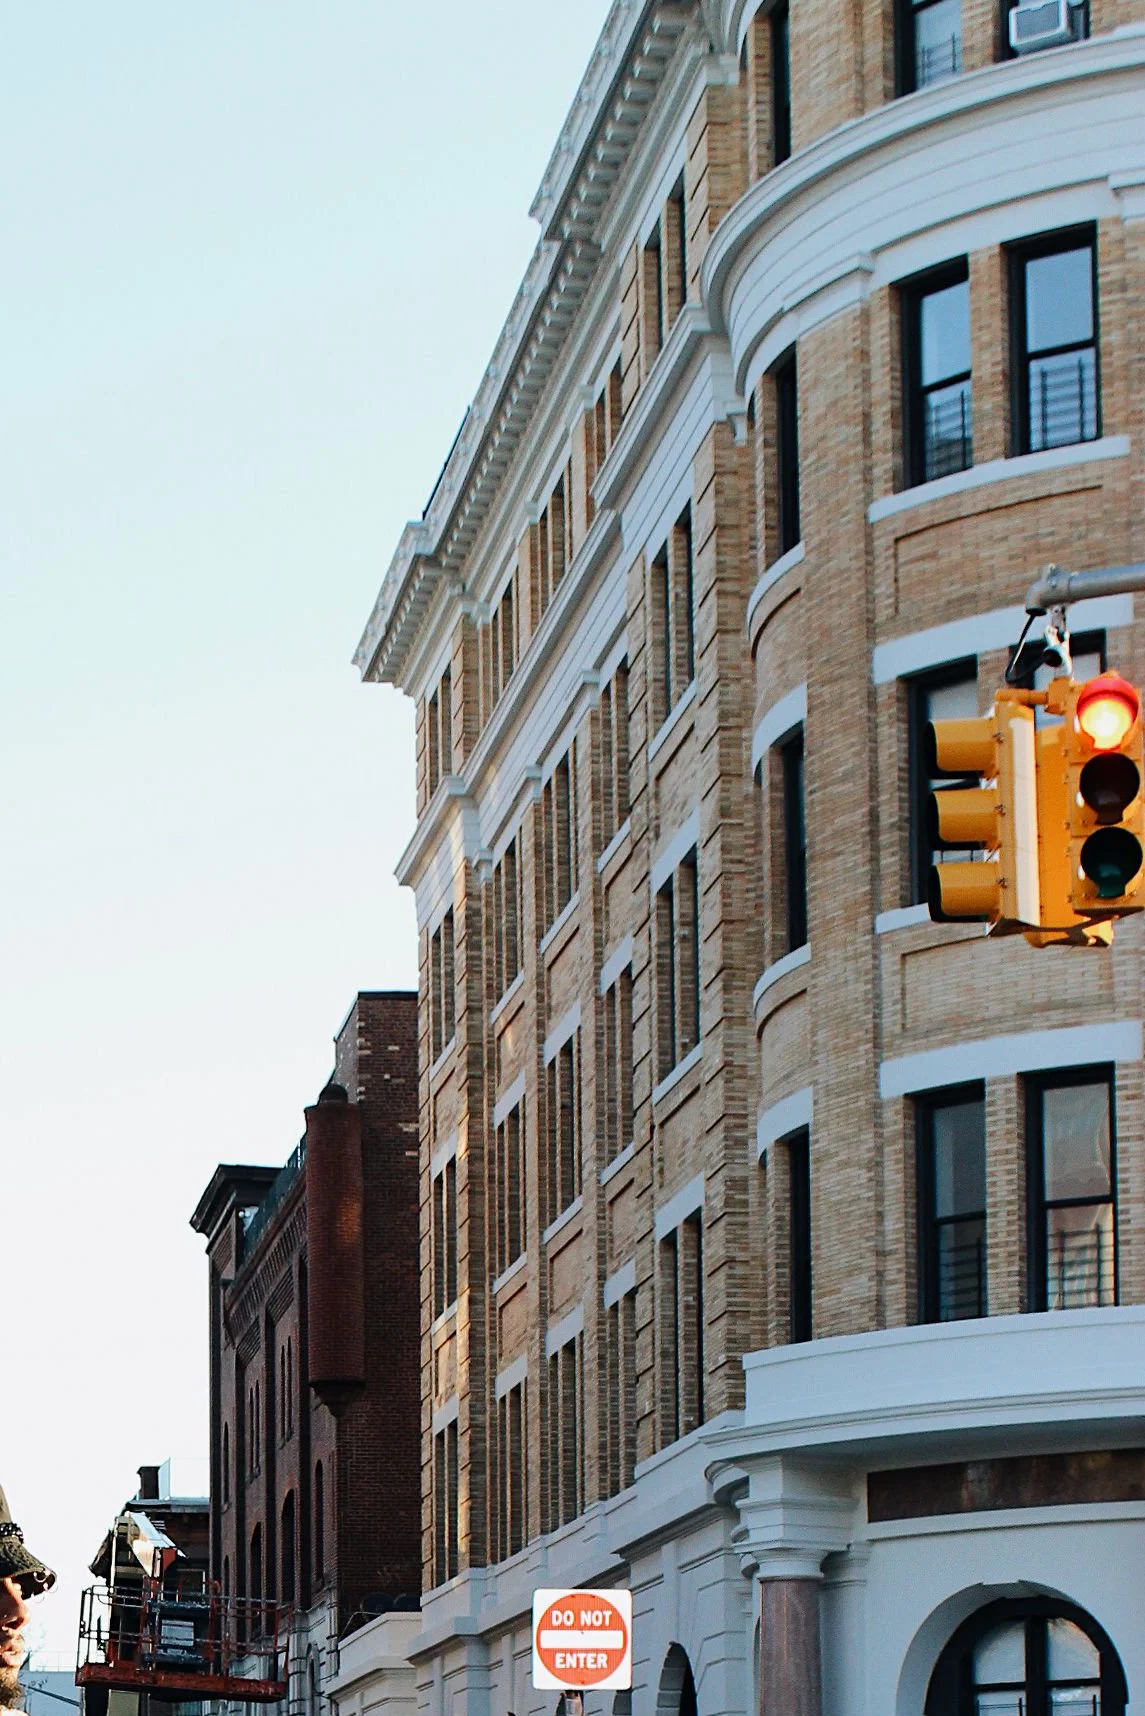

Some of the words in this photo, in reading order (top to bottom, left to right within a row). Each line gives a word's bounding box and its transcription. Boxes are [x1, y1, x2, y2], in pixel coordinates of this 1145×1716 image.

[551, 1609, 574, 1626] DO
[580, 1610, 612, 1626] NOT
[555, 1652, 608, 1669] ENTER
